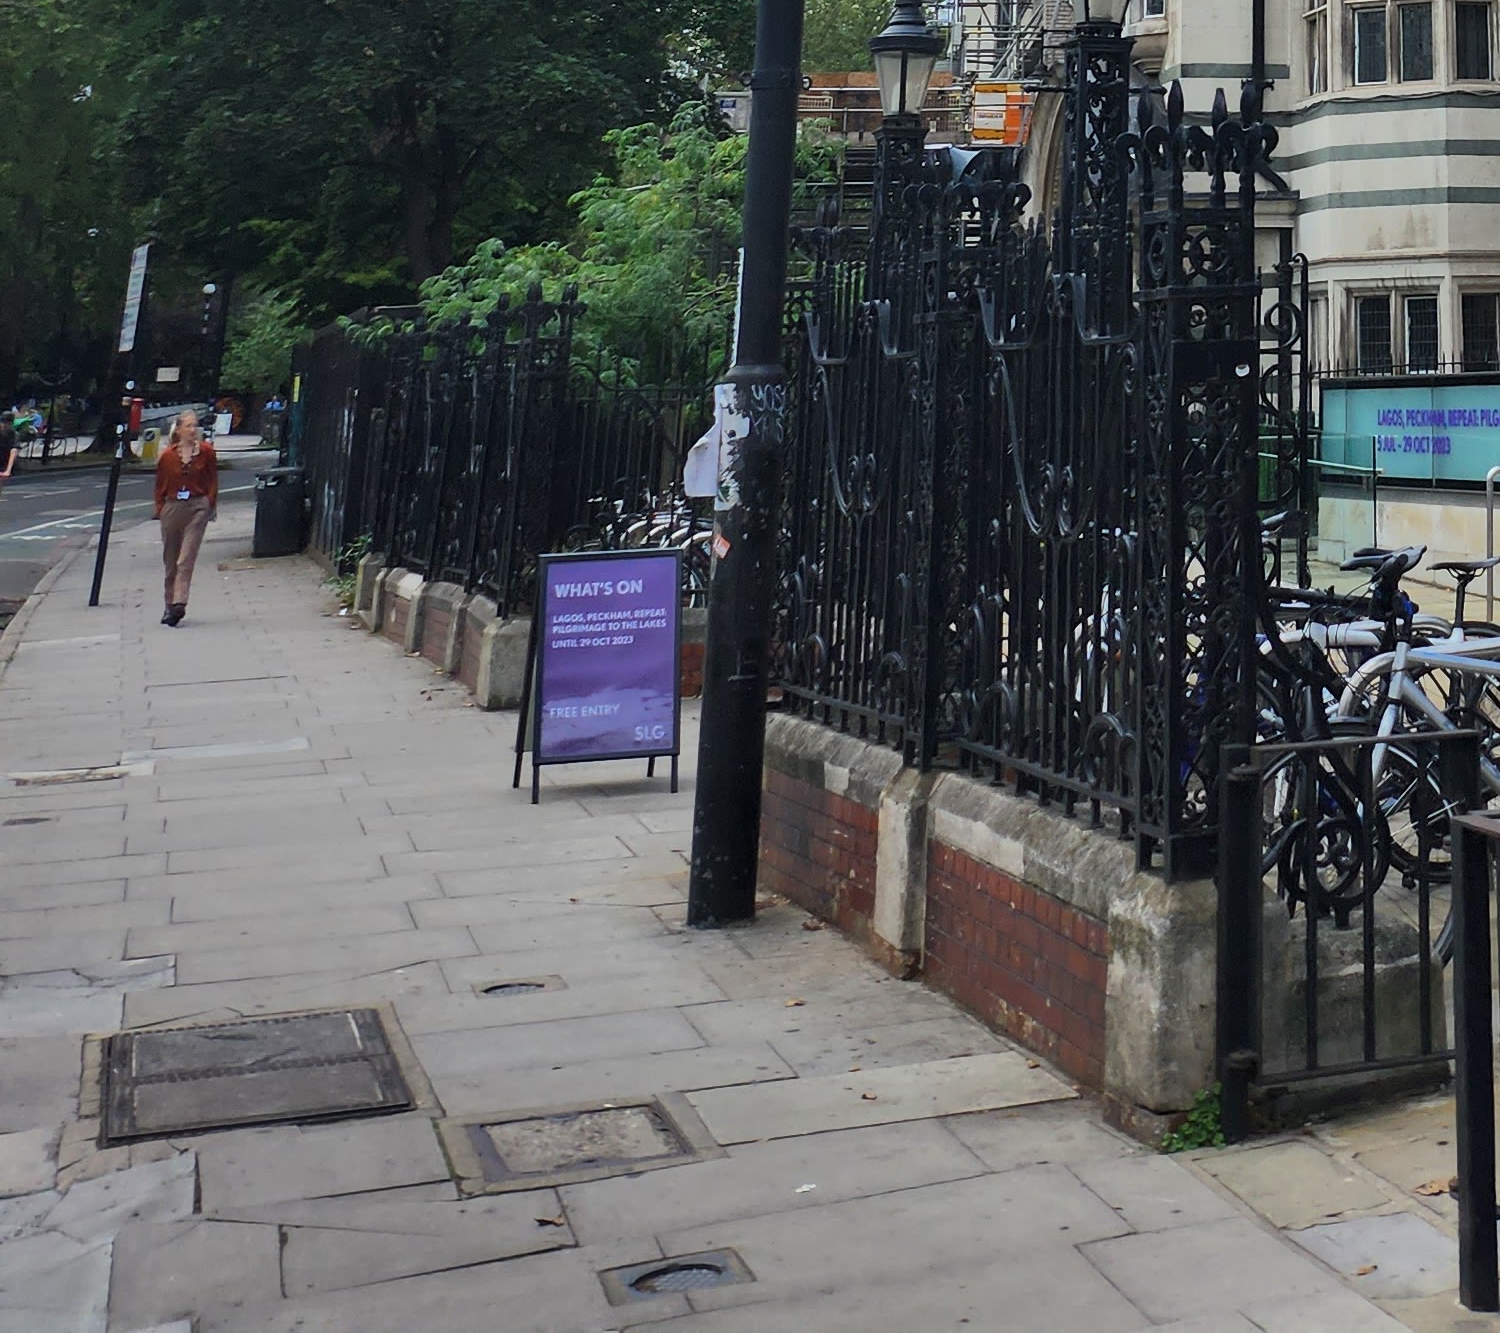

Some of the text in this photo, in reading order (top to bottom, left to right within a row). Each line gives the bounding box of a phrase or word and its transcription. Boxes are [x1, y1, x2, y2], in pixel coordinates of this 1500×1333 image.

[1377, 409, 1405, 429] LAGOS,
[1405, 409, 1447, 429] PECKHAM,
[1383, 436, 1396, 452] JUL
[1402, 436, 1412, 453] 29
[1413, 436, 1431, 454] OCT
[555, 579, 643, 598] WHAT'S ON
[553, 613, 586, 623] LAGOS,
[587, 610, 633, 622] PECKHAM,
[552, 619, 666, 634] PILGRIMAGE TO THE LAKES
[552, 635, 634, 649] UNTIL 29 OCT 2023
[550, 703, 621, 719] FREE ENTRY
[633, 725, 665, 741] SLG
